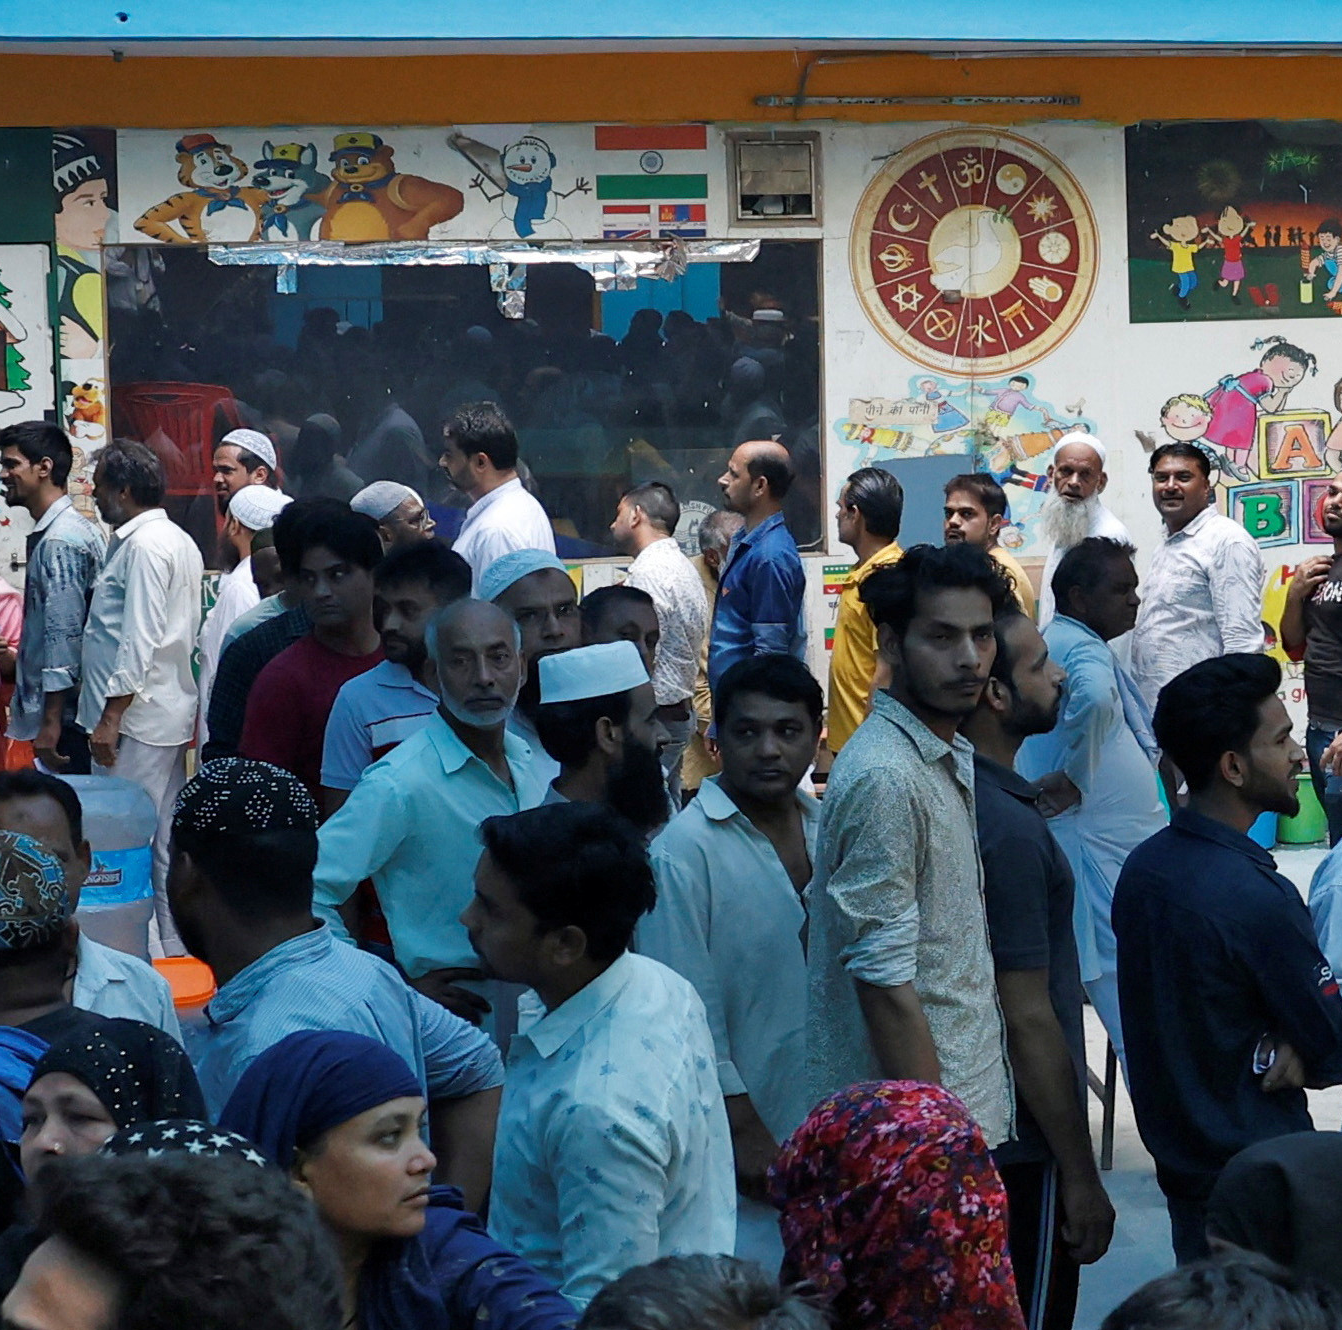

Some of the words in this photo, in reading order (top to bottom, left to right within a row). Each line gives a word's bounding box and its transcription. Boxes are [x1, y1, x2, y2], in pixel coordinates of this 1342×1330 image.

[865, 404, 883, 416] पीने
[1270, 424, 1323, 470] A
[1240, 493, 1286, 539] B
